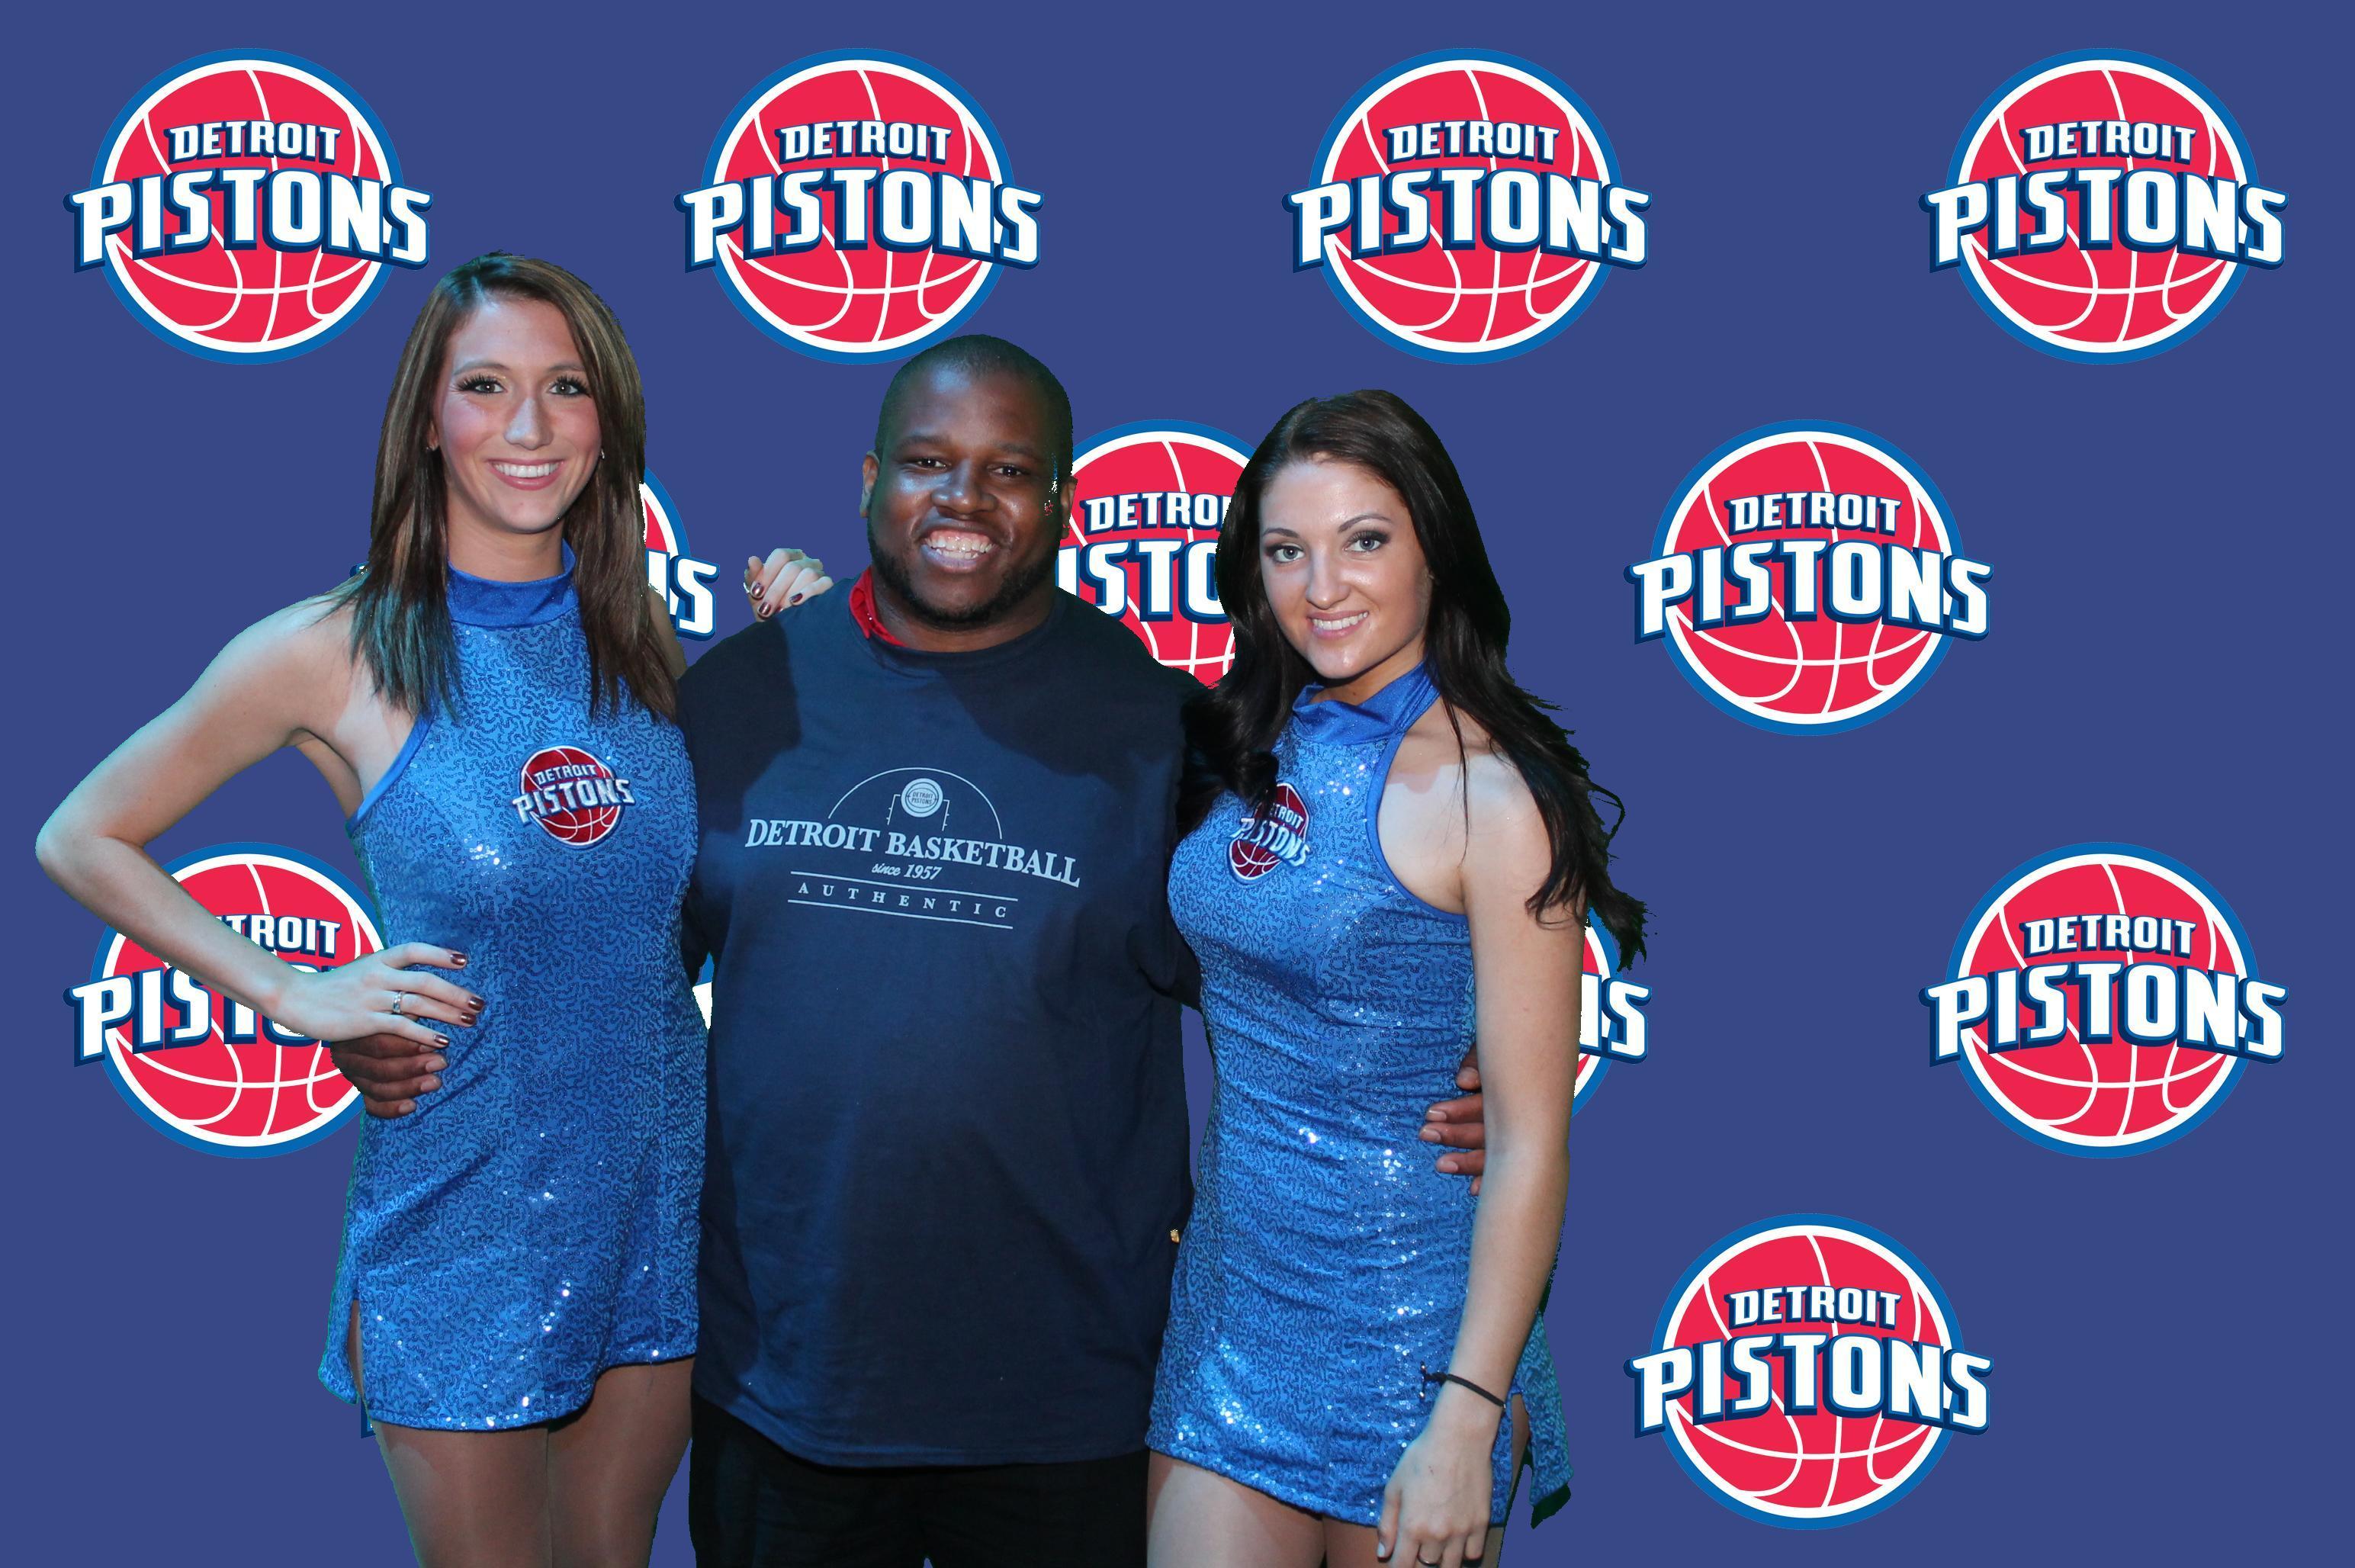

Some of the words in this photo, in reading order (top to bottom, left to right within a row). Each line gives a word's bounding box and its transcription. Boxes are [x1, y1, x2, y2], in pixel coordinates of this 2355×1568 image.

[167, 120, 342, 162] DETROIT
[778, 120, 953, 162] DETROIT
[1386, 120, 1560, 162] DETROIT
[2022, 120, 2197, 162] DETROIT
[69, 168, 432, 267] PISTONS
[680, 168, 1043, 267] PISTONS
[1287, 168, 1650, 267] PISTONS
[1924, 168, 2287, 267] PISTONS
[1727, 491, 1902, 533] DETROIT
[1629, 539, 1992, 638] PISTONS
[534, 764, 598, 786] DETROIT
[512, 778, 636, 825] PISTONS
[744, 818, 881, 853] DETROIT
[885, 831, 1081, 888] BASKETBALL
[871, 863, 901, 877] since
[903, 863, 942, 881] 1957
[798, 882, 1007, 919] AUTHENTIC
[221, 914, 342, 955] TROIT
[2022, 914, 2197, 956] DETROIT
[1924, 962, 2287, 1061] PISTONS
[1727, 1285, 1902, 1327] DETROIT
[1629, 1333, 1992, 1432] PISTONS
